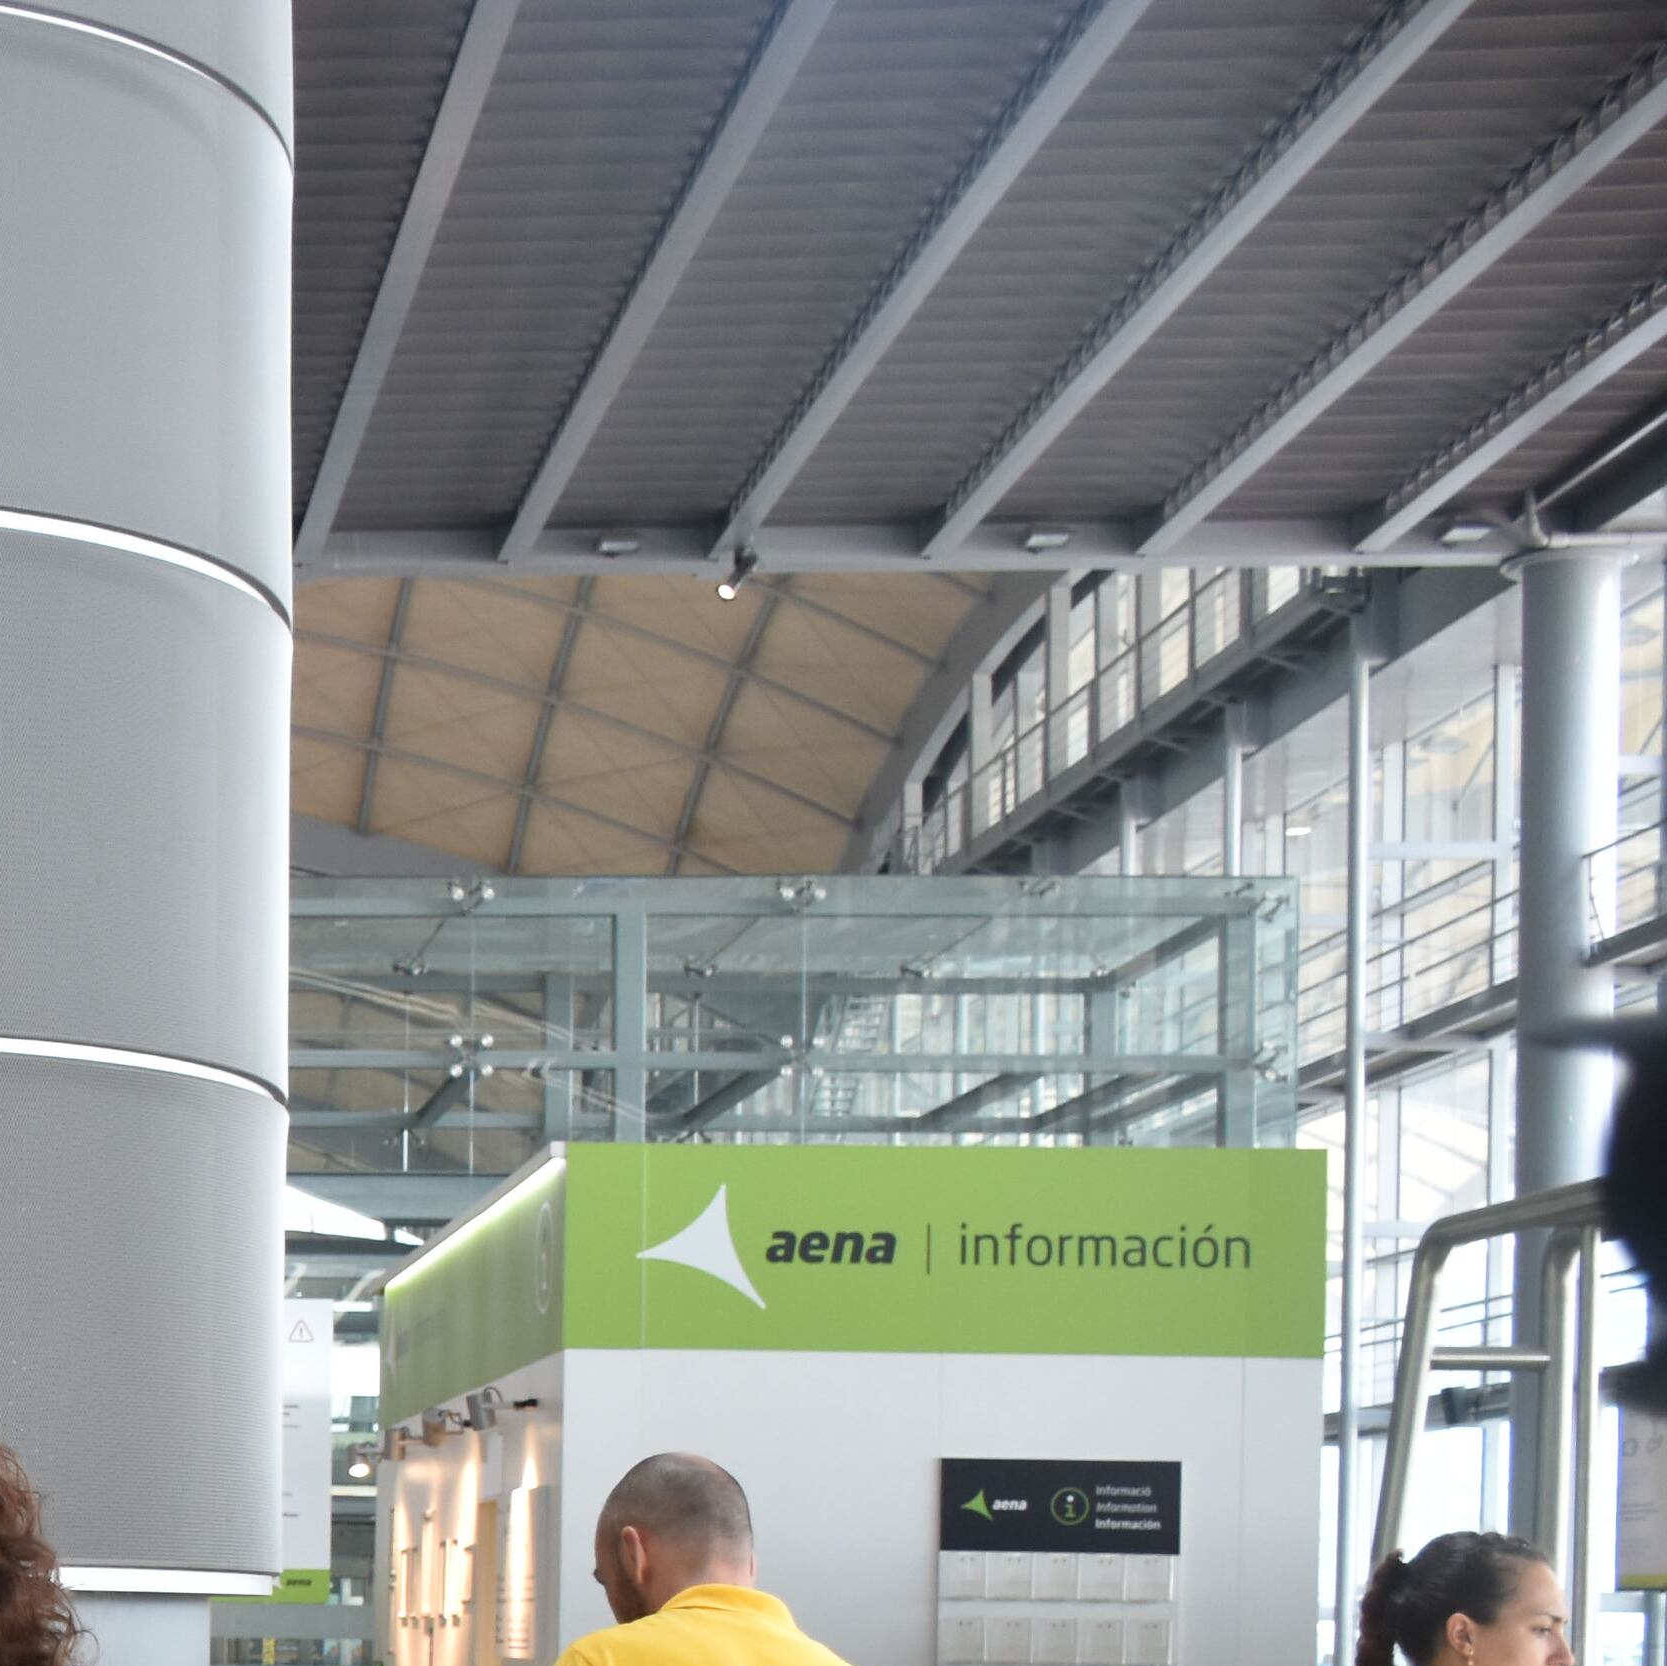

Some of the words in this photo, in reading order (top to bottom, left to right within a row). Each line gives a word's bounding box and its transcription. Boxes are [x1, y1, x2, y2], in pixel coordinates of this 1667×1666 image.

[766, 1228, 897, 1265] aena
[959, 1222, 1252, 1269] información
[1095, 1485, 1152, 1497] Informació
[992, 1499, 1028, 1511] aena
[1095, 1502, 1157, 1514] Information
[1095, 1518, 1161, 1530] Información
